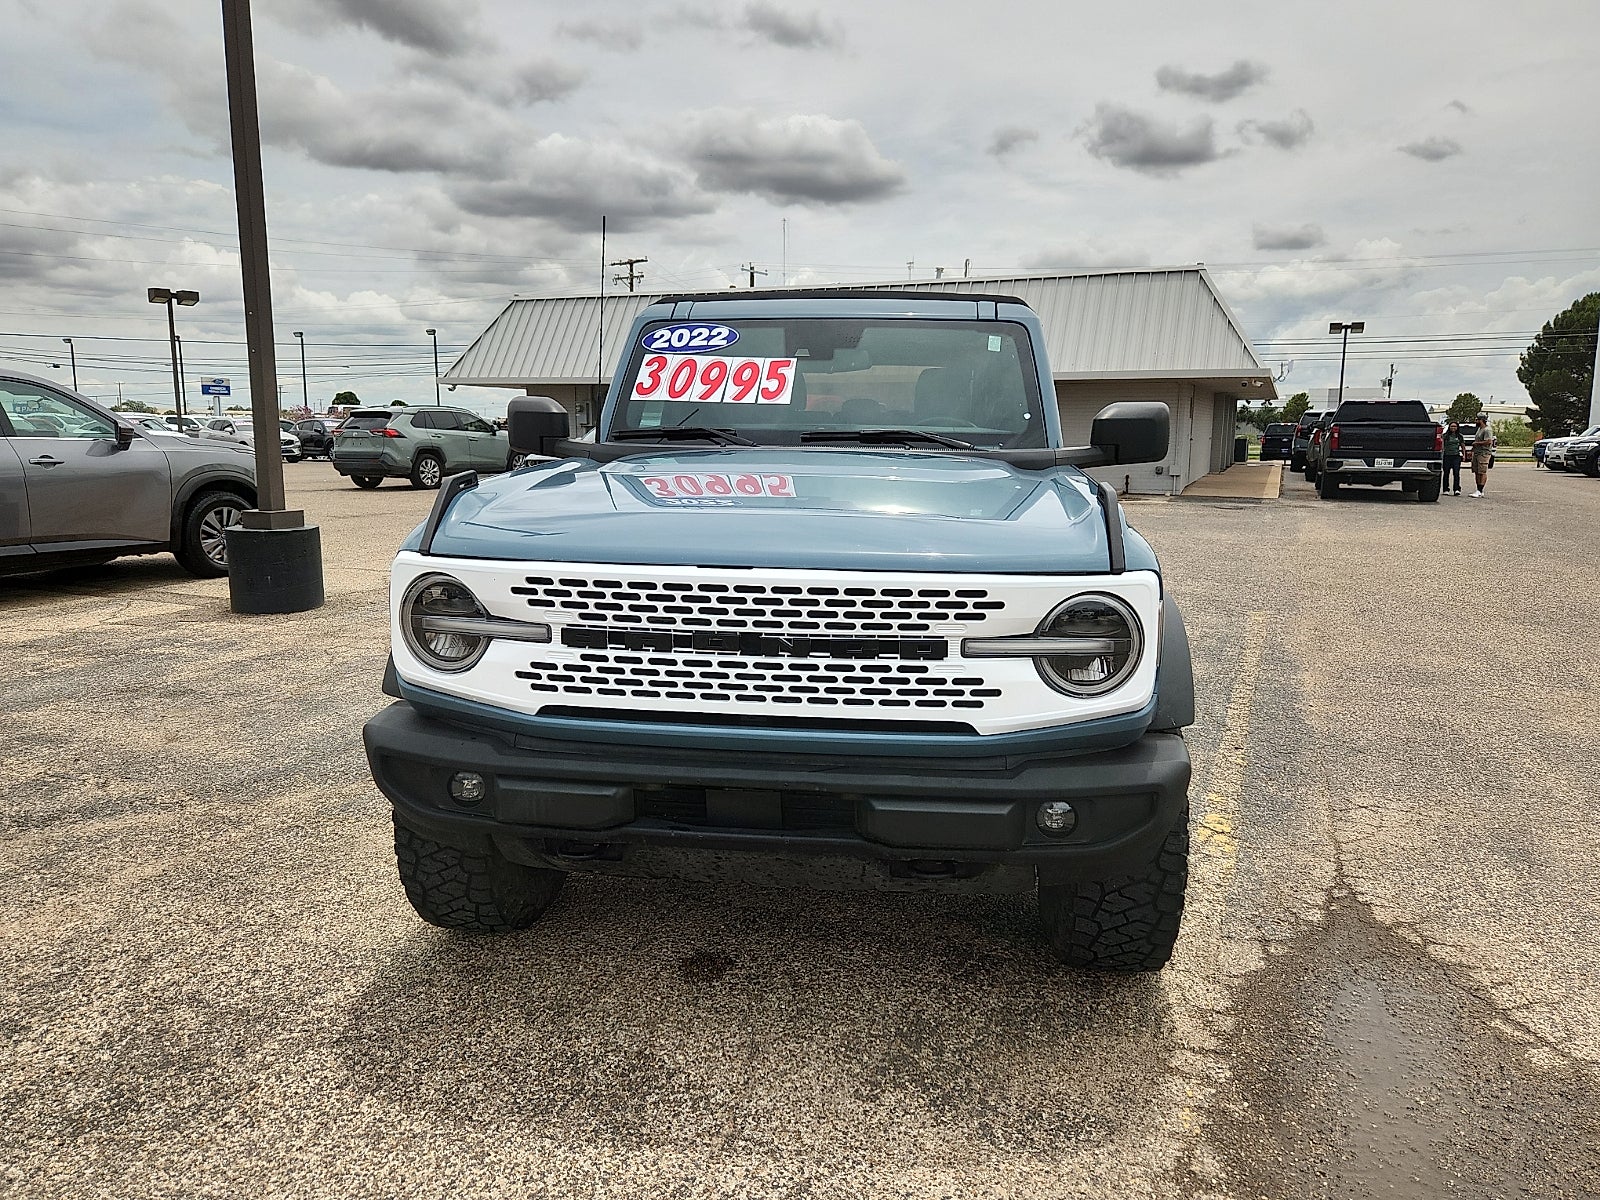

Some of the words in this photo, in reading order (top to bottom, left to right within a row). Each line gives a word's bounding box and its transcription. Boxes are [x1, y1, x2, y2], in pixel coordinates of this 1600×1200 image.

[651, 327, 730, 349] 2022
[635, 355, 793, 402] 30995
[561, 627, 949, 660] BRONCO
